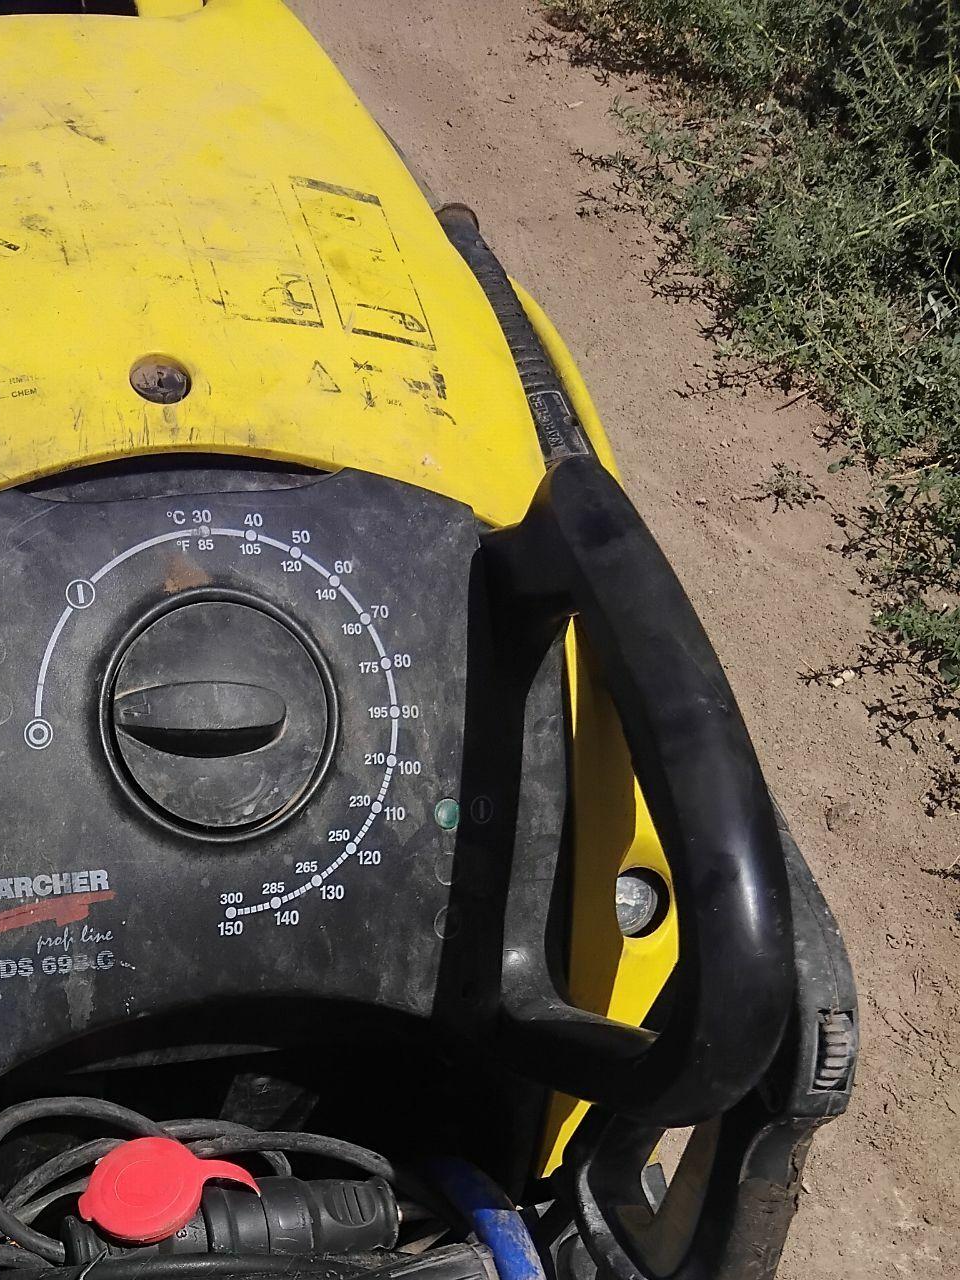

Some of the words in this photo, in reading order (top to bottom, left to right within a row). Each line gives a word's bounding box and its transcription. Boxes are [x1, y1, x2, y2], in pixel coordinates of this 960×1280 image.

[192, 509, 212, 523] 30
[244, 513, 263, 527] 40
[291, 530, 311, 544] 50
[197, 539, 214, 551] 85
[240, 543, 262, 555] 105
[281, 561, 302, 573] 120
[334, 560, 352, 574] 60
[316, 589, 337, 600] 140
[370, 605, 389, 619] 70
[341, 623, 362, 635] 160
[358, 661, 379, 674] 175
[394, 653, 411, 668] 80
[368, 706, 388, 719] 195
[401, 705, 419, 719] 90
[364, 752, 385, 765] 210
[398, 761, 421, 775] 100
[349, 795, 371, 808] 230
[384, 806, 405, 821] 110
[328, 829, 350, 842] 250
[357, 851, 381, 865] 120
[295, 861, 318, 874] 265
[262, 882, 285, 895] 285
[319, 885, 345, 900] 130
[219, 892, 243, 905] 300
[274, 910, 300, 926] 140
[217, 921, 243, 936] 150
[36, 926, 74, 954] profi
[81, 925, 114, 942] line
